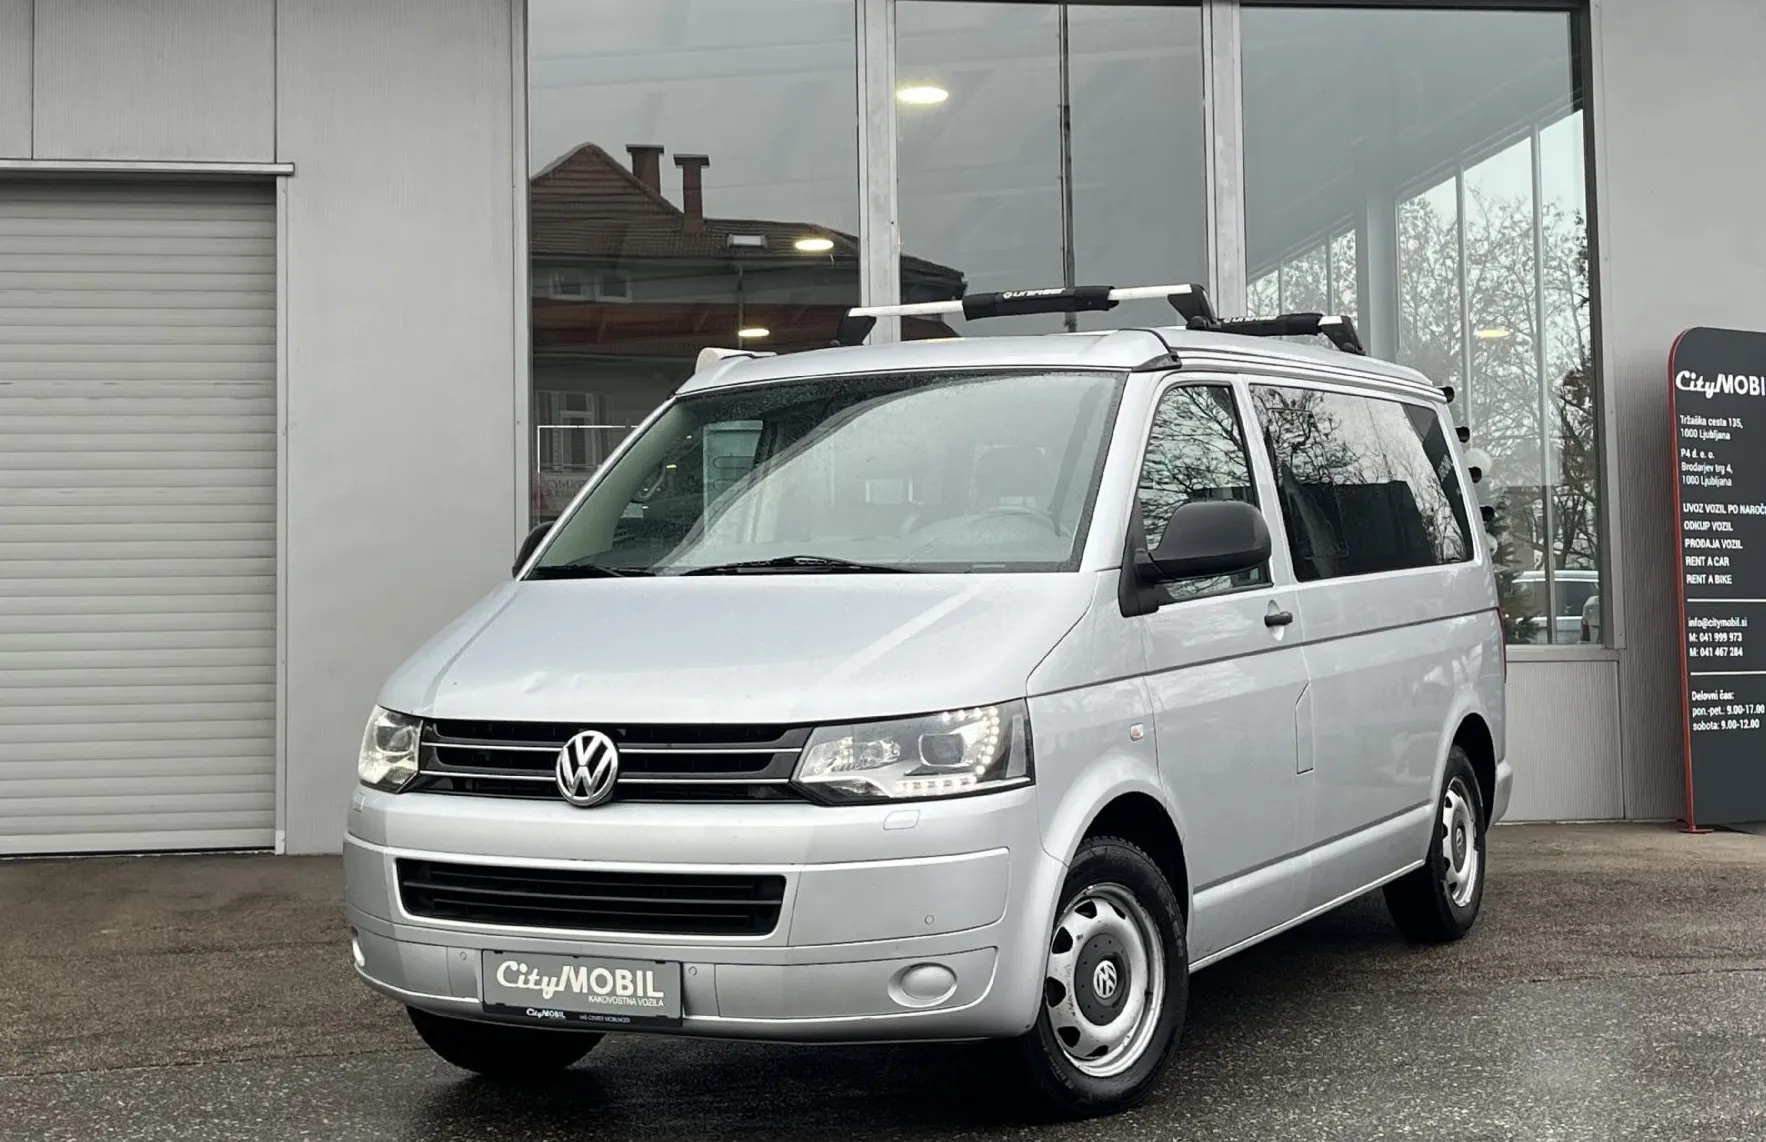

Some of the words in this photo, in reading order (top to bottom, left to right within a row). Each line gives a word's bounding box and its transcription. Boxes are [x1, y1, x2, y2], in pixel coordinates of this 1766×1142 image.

[1708, 418, 1727, 427] cesta
[1728, 418, 1743, 429] 135,
[1681, 429, 1698, 438] 1000
[1699, 429, 1731, 441] Ljubljana
[1680, 448, 1690, 458] P4
[1681, 462, 1713, 474] Brodarjev
[1715, 463, 1725, 475] trg
[1682, 475, 1699, 485] 1000
[1700, 476, 1732, 487] Ljubljana
[1683, 503, 1703, 513] UVOZ
[1705, 504, 1726, 514] VOZIL
[1728, 505, 1738, 514] PO
[1684, 520, 1710, 530] ODKUP
[1712, 521, 1733, 531] VOZIL
[1684, 538, 1720, 548] PRODAJA
[1722, 539, 1743, 549] VOZIL
[1685, 556, 1706, 566] RENT
[1707, 557, 1713, 566] A
[1714, 557, 1730, 566] CAR
[1686, 574, 1706, 584] RENT
[1708, 575, 1713, 584] A
[1715, 575, 1732, 584] BIKE
[1688, 617, 1748, 629] info@citymobil.si
[1689, 633, 1698, 642] M:
[1699, 632, 1712, 642] 041
[1714, 632, 1727, 642] 999
[1729, 632, 1742, 642] 973
[1689, 648, 1699, 657] M:
[1700, 648, 1713, 657] 041
[1715, 648, 1728, 657] 467
[1692, 690, 1718, 701] Delovni
[1719, 689, 1734, 700] čas:
[1726, 704, 1765, 715] 9.00-17.00
[1693, 720, 1720, 731] sobota:
[1721, 719, 1760, 730] 9.00-12.00
[496, 960, 664, 999] CityMOBIL
[588, 995, 637, 1006] KAKOVOSTNA
[638, 998, 664, 1007] VOZILA
[526, 1008, 566, 1019] CityMOBIL
